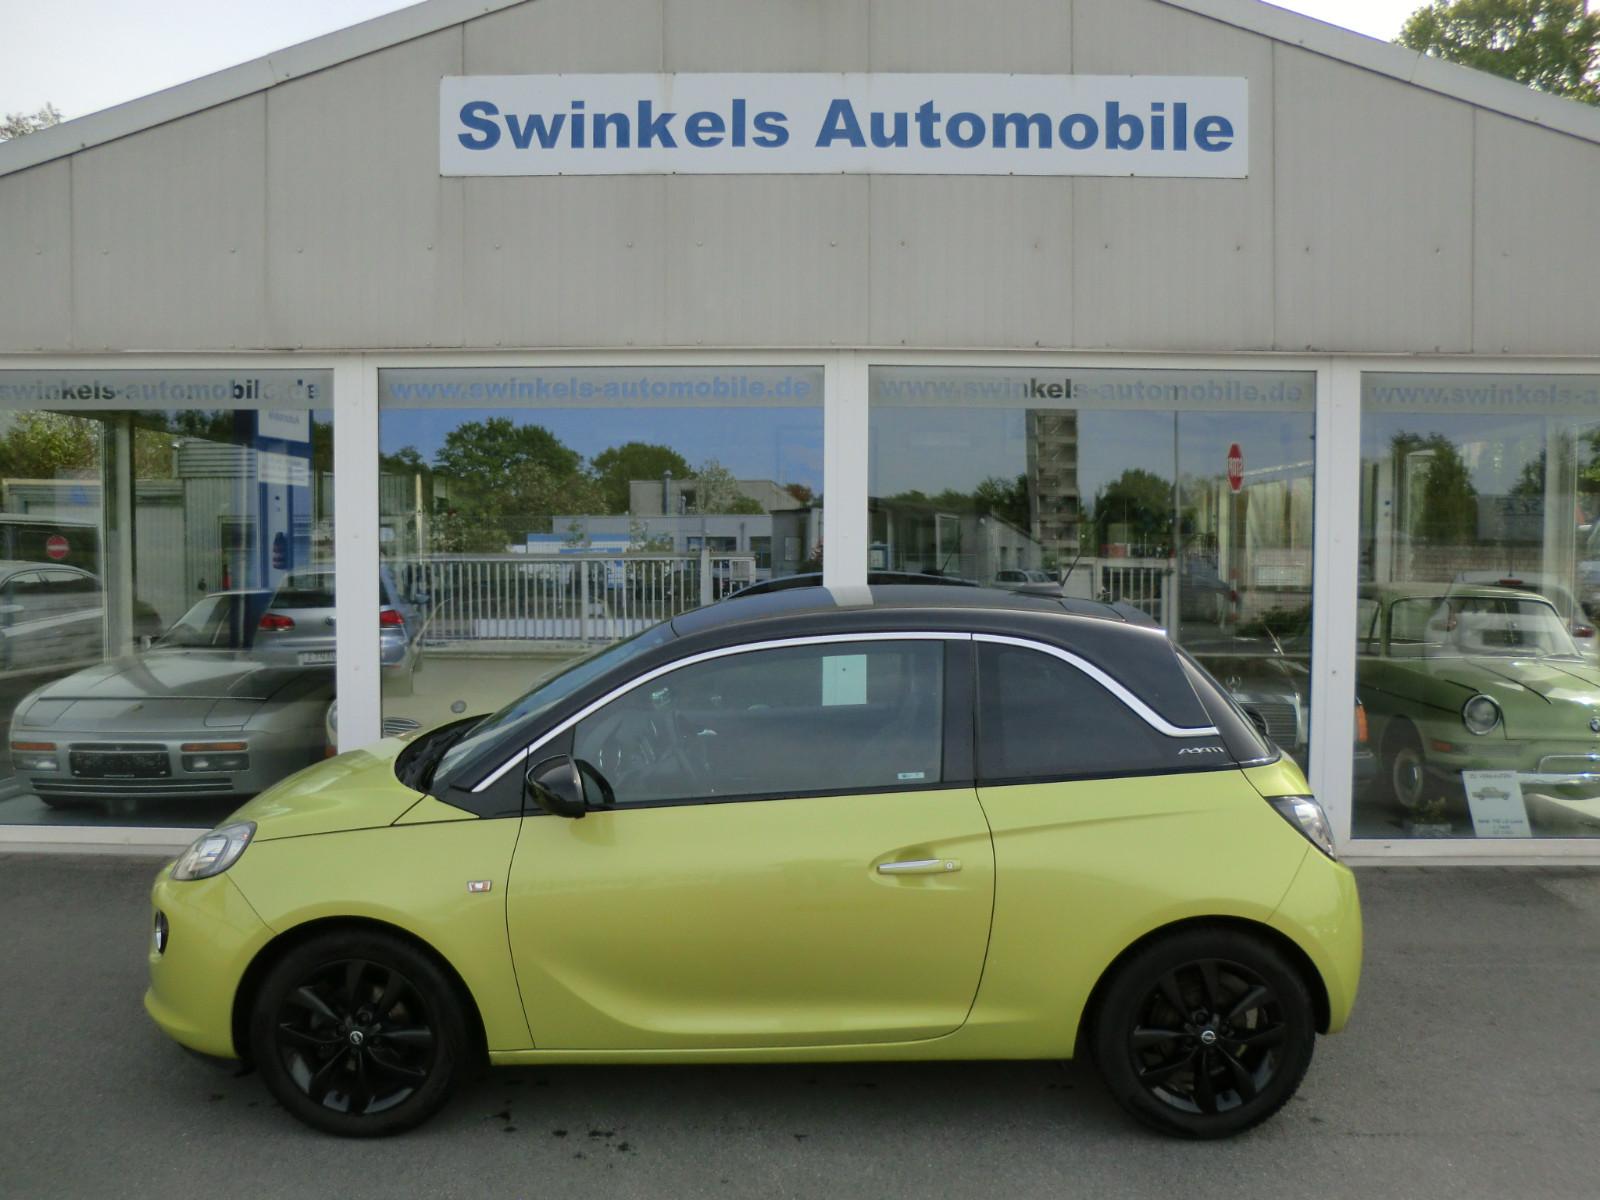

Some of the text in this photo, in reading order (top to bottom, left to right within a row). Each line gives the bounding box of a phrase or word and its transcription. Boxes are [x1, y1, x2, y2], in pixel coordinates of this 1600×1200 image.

[457, 98, 1234, 152] Swinkels Automobile
[390, 376, 811, 400] www.swinkels-automobile.de
[879, 377, 1302, 402] www.swinkels-automobile.de
